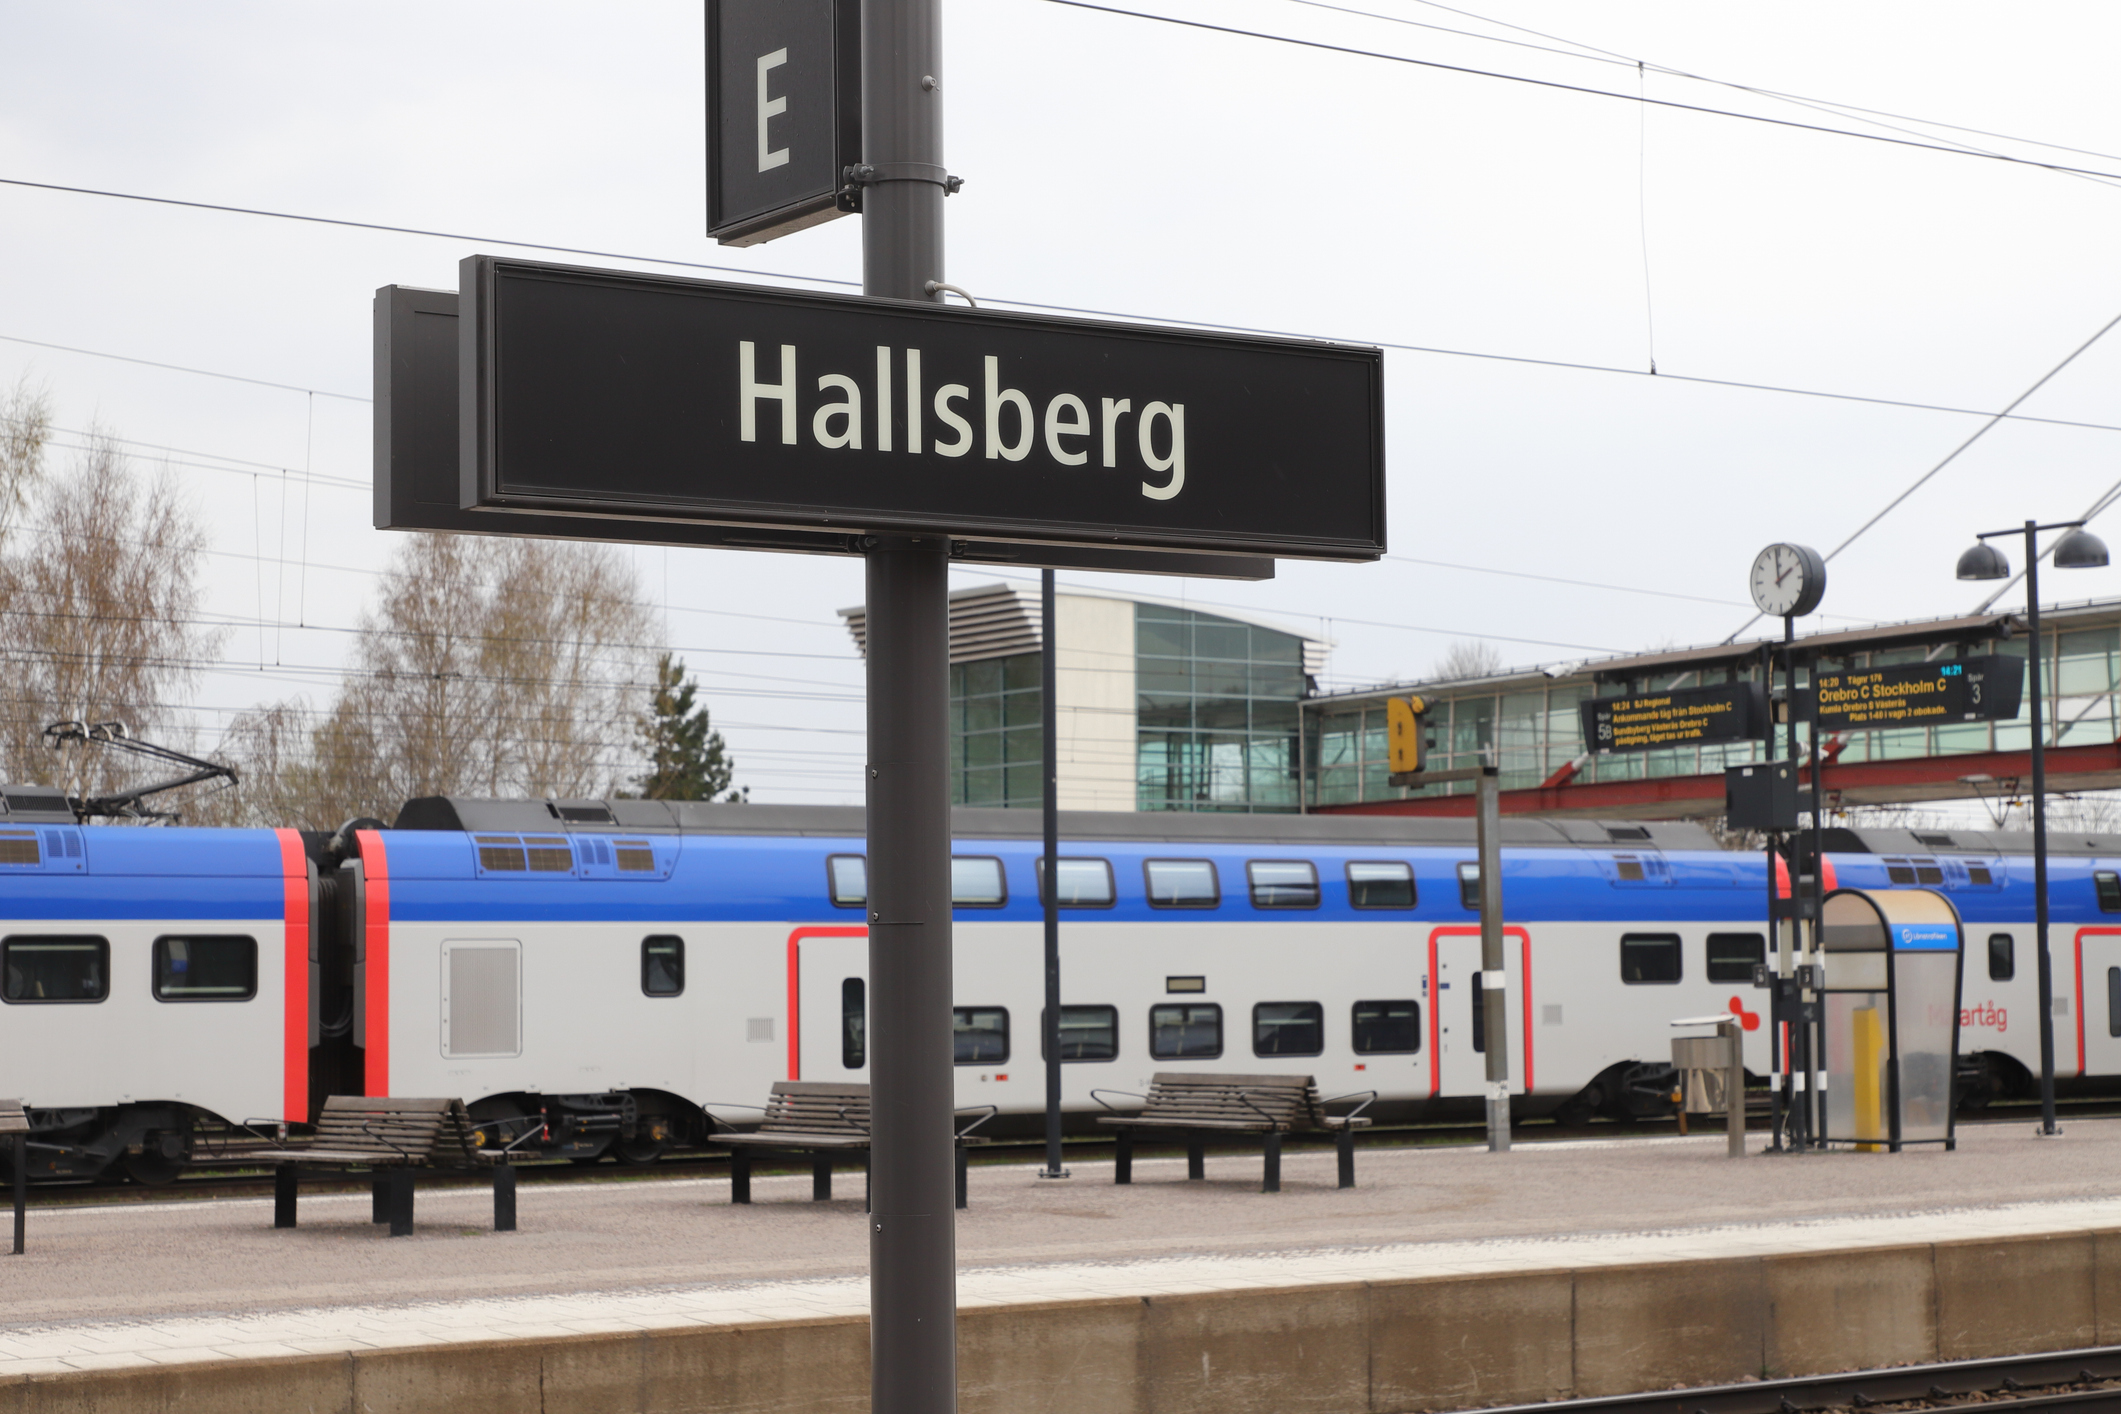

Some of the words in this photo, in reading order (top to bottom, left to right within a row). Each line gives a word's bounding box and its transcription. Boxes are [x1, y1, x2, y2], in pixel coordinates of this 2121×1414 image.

[757, 47, 790, 174] E
[739, 340, 1186, 501] Hallsberg
[1940, 665, 1962, 676] 14:21
[1819, 677, 1839, 688] 14:20
[1967, 673, 1984, 682] Spår
[1861, 685, 1870, 699] C
[1873, 681, 1934, 698] Stockholm
[1937, 678, 1947, 692] C
[1972, 684, 1981, 704] 3
[1644, 697, 1671, 709] Regional
[1820, 704, 1842, 714] Kumla
[1613, 711, 1658, 723] Ankommande
[1672, 707, 1687, 717] från
[1688, 703, 1725, 715] Stockholm
[1726, 701, 1732, 712] C
[1849, 712, 1867, 722] Plats
[1888, 709, 1906, 720] vagn
[1907, 708, 1912, 717] 2
[1703, 718, 1708, 726] C
